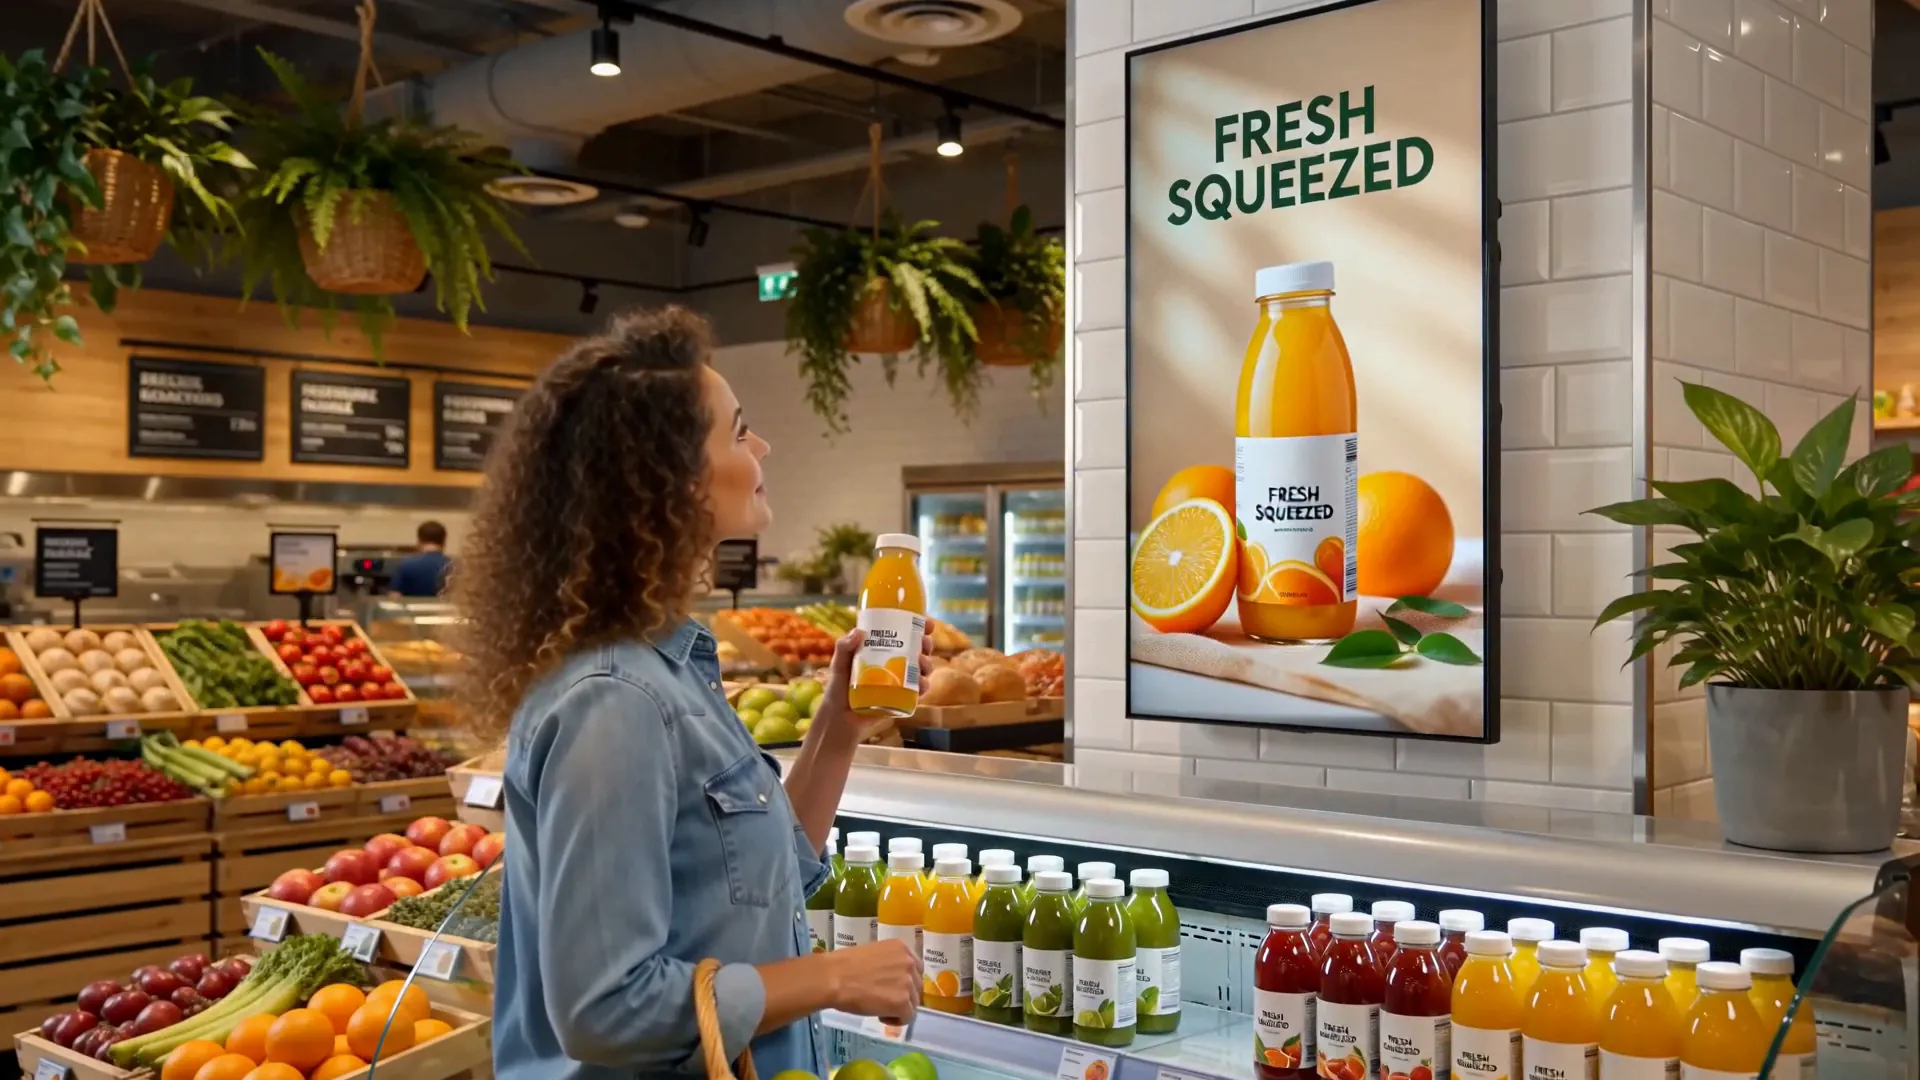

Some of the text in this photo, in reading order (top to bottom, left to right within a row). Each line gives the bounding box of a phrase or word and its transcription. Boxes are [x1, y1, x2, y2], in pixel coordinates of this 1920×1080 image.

[1215, 85, 1375, 163] FRESH
[1167, 136, 1434, 226] SQUEEZED
[1255, 504, 1334, 523] SQUEEZED
[1268, 486, 1320, 503] FRESH
